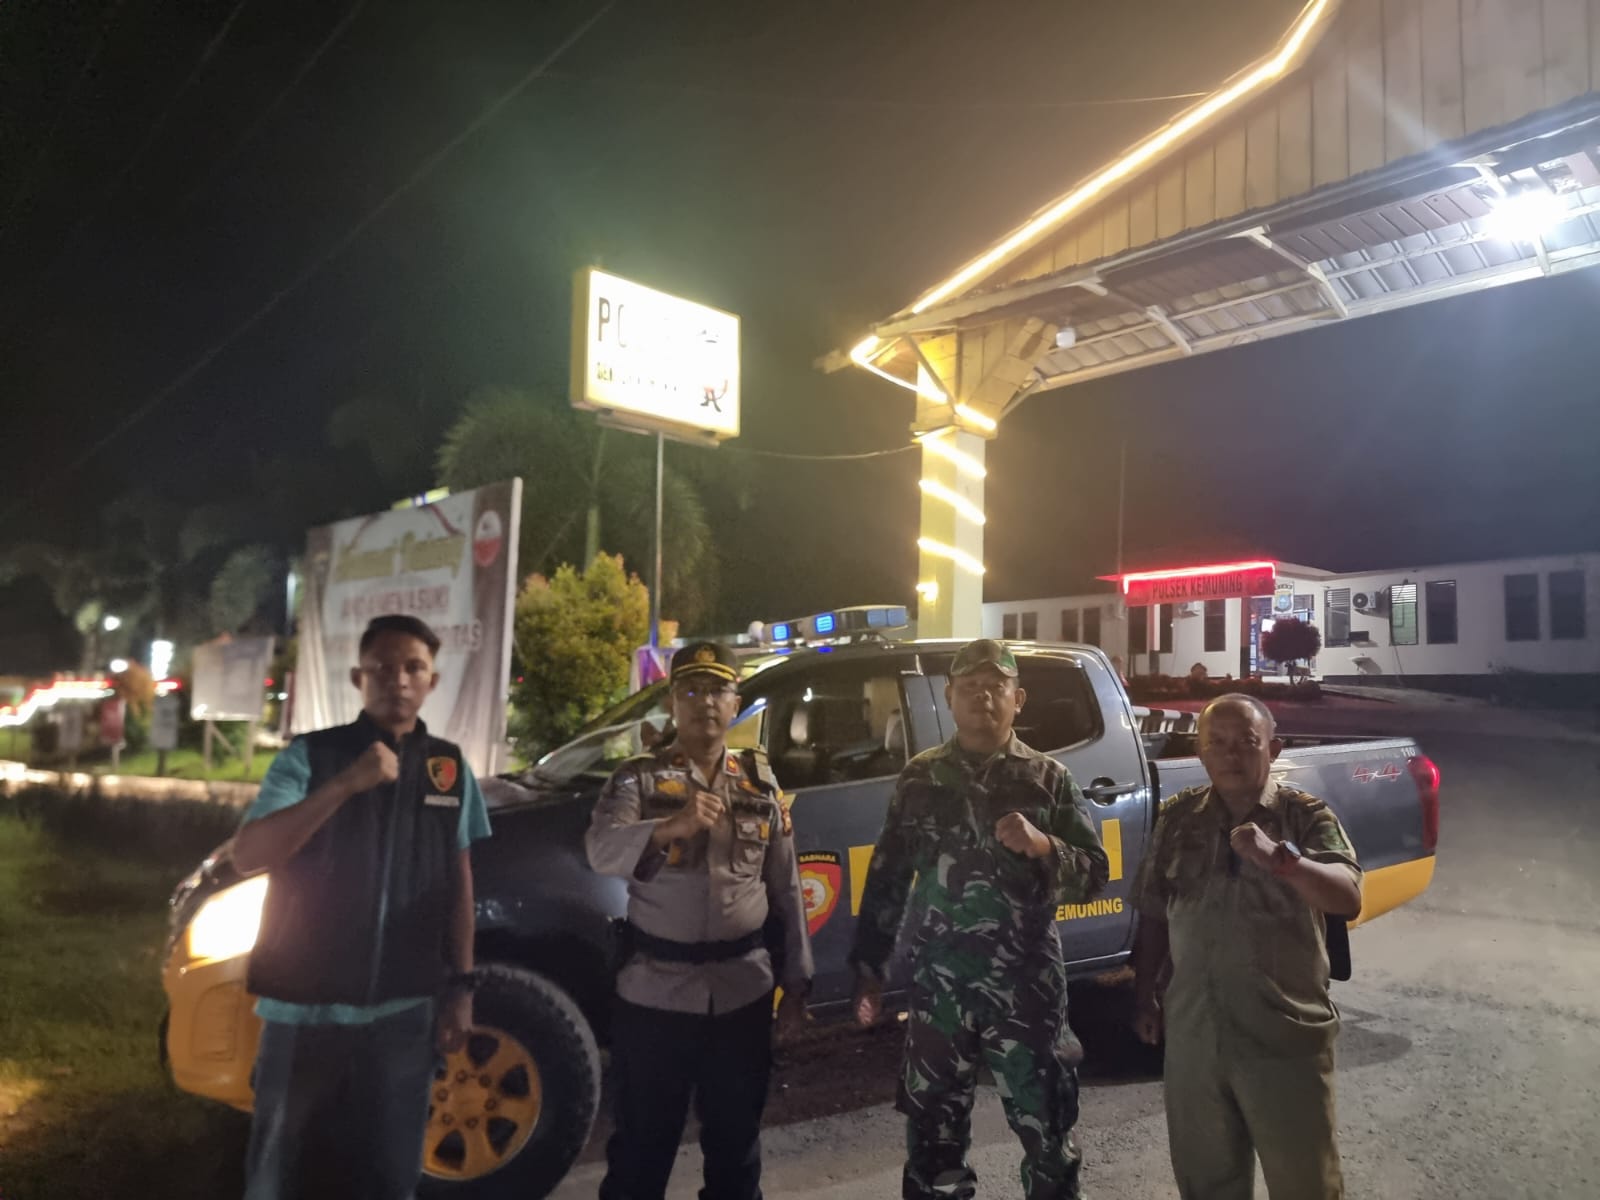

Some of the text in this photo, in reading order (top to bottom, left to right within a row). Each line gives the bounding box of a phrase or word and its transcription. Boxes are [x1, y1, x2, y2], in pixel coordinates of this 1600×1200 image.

[1152, 574, 1243, 599] POLSEK KEMUNING
[1055, 897, 1124, 922] EMUNING
